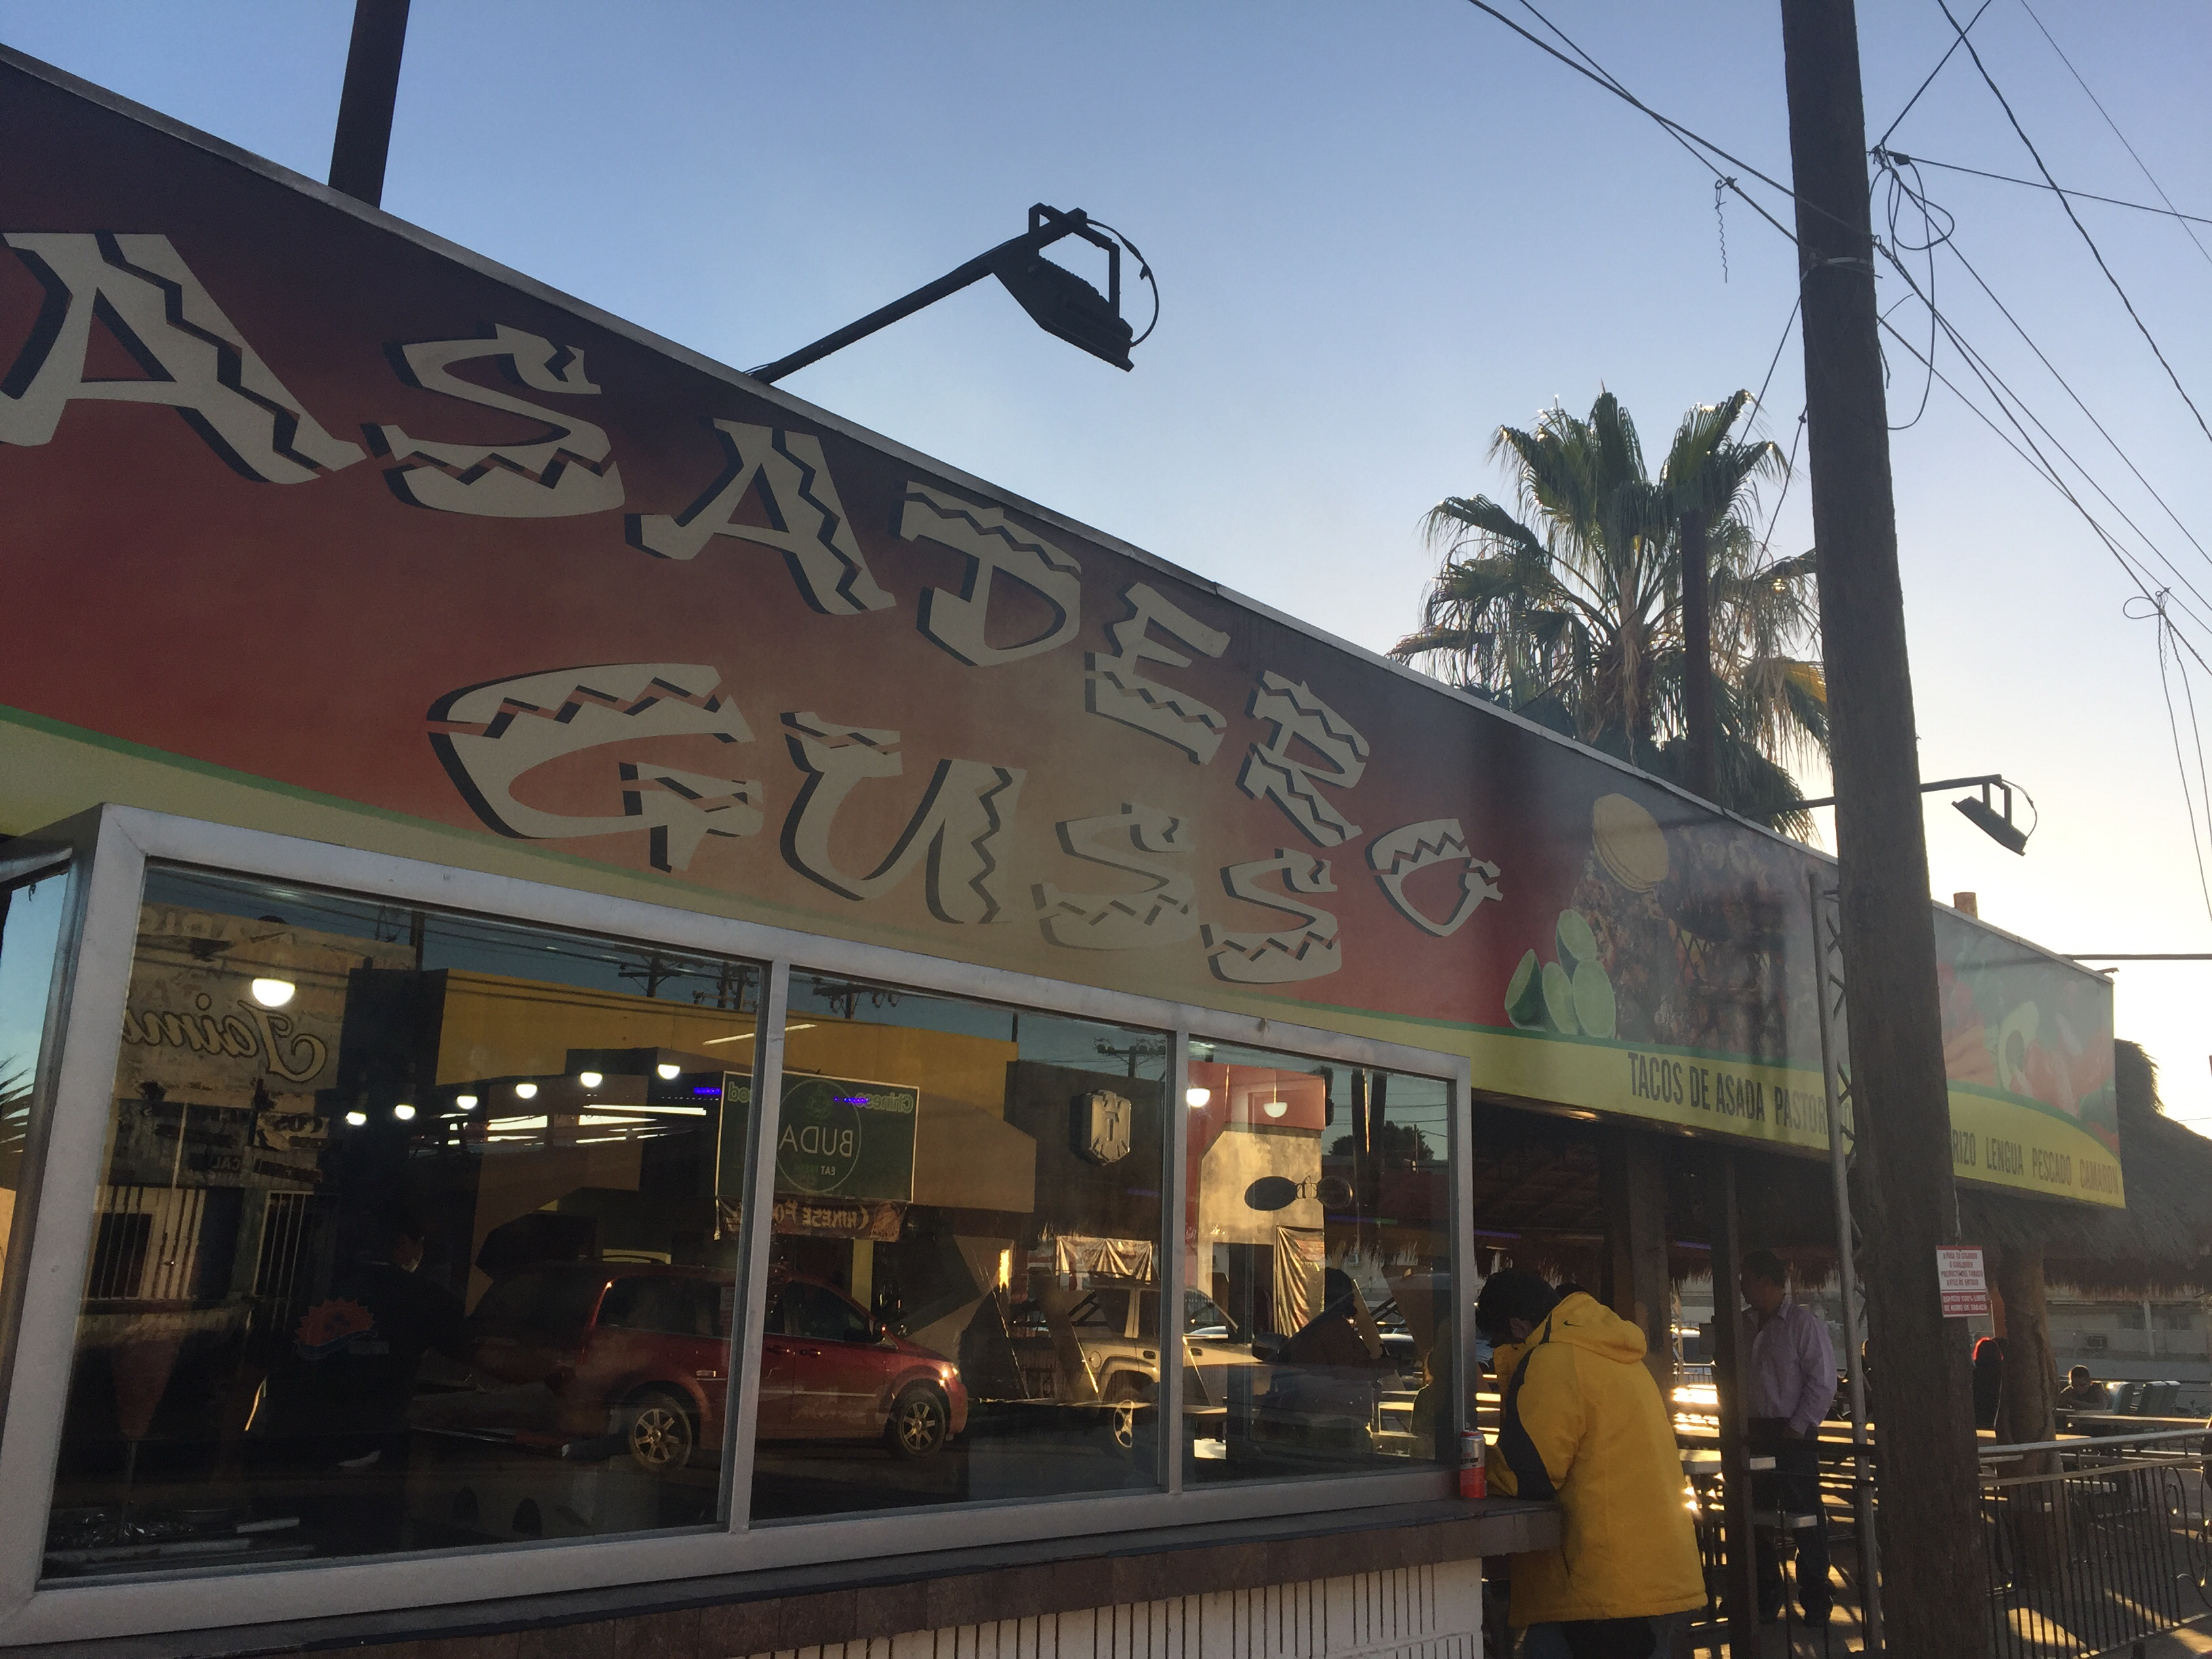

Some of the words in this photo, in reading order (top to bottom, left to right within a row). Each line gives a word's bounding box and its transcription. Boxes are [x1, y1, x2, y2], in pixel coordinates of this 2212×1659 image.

[426, 662, 1343, 984] GUSS
[1628, 1052, 1684, 1105] TACOS
[1689, 1065, 1711, 1111] DE
[1716, 1072, 1765, 1122] ASADA
[1774, 1086, 1828, 1135] PASTOR
[1952, 1129, 1976, 1167] RIZO
[1985, 1136, 2024, 1176] LENGUA
[2032, 1147, 2072, 1187] PESCADO
[2080, 1159, 2119, 1195] CAMARON
